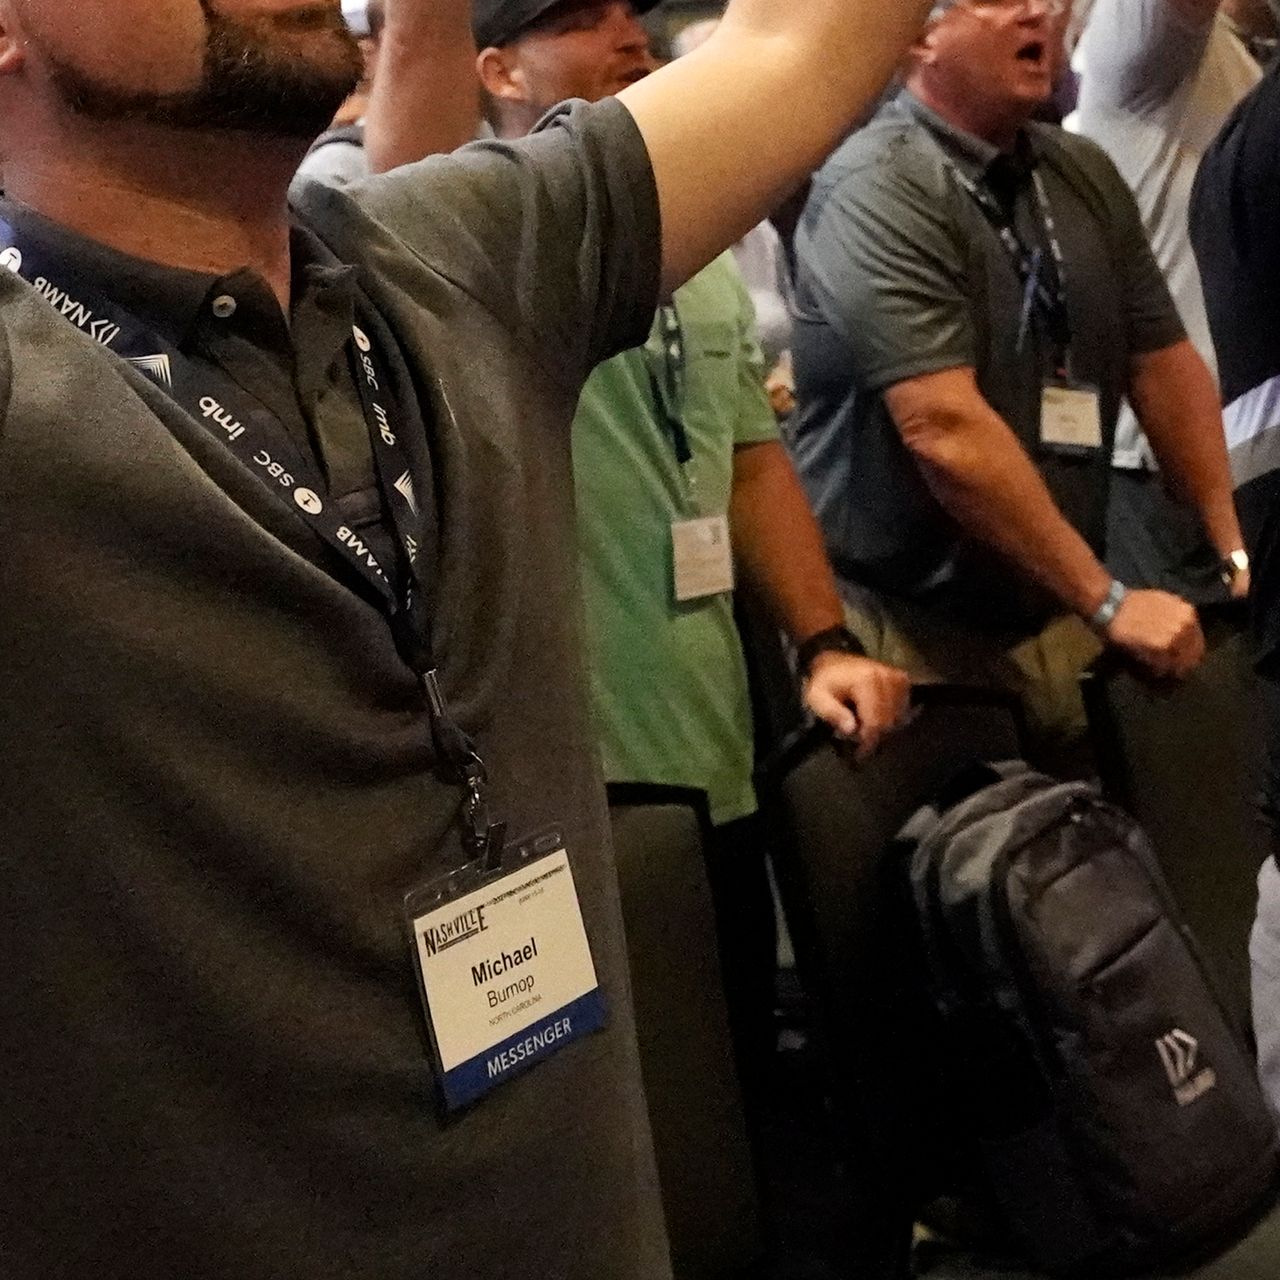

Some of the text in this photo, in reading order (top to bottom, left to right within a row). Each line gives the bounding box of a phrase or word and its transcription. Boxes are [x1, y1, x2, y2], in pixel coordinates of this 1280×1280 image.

[34, 276, 92, 327] NAMB
[360, 352, 379, 391] SBC
[199, 396, 246, 441] imb
[372, 402, 396, 446] imb
[253, 450, 295, 487] SBC
[336, 526, 382, 575] AMB
[423, 904, 489, 958] NASHVILLE
[471, 936, 538, 987] Michael
[487, 975, 535, 1008] Burnop
[487, 1017, 572, 1078] MESSENGER
